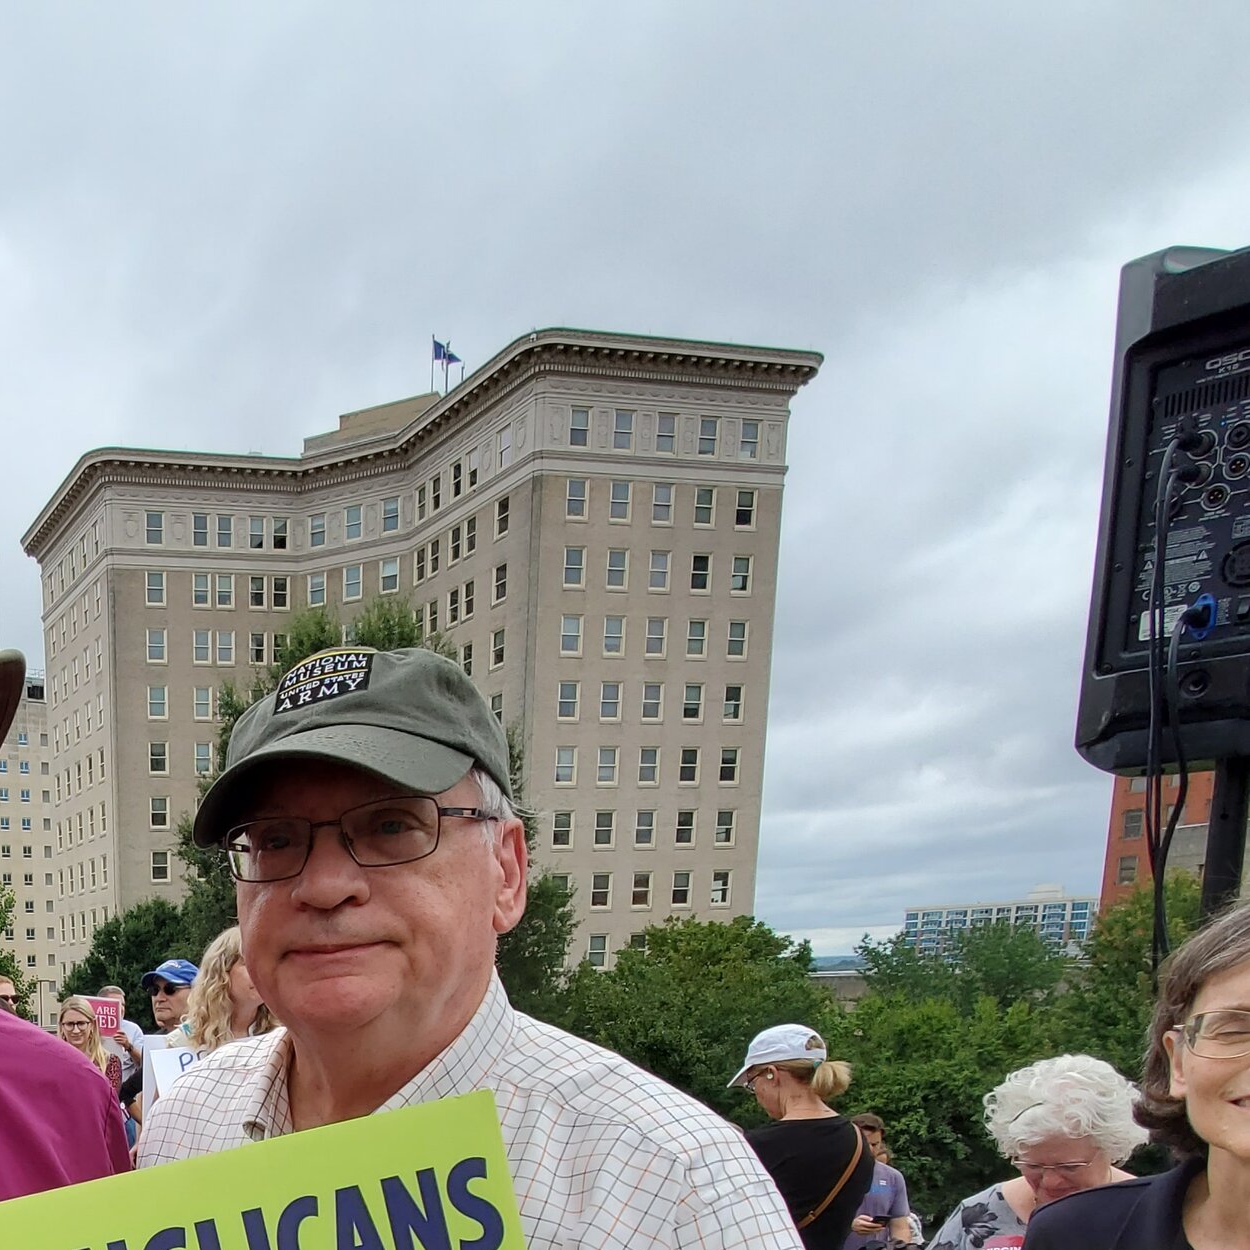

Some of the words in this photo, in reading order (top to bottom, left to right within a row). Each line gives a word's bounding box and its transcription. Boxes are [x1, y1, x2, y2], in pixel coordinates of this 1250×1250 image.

[284, 660, 366, 688] MUSEUM
[286, 653, 367, 680] NATIONAL
[276, 677, 364, 712] ARMY
[280, 680, 320, 699] UNITED
[323, 671, 365, 684] STATES
